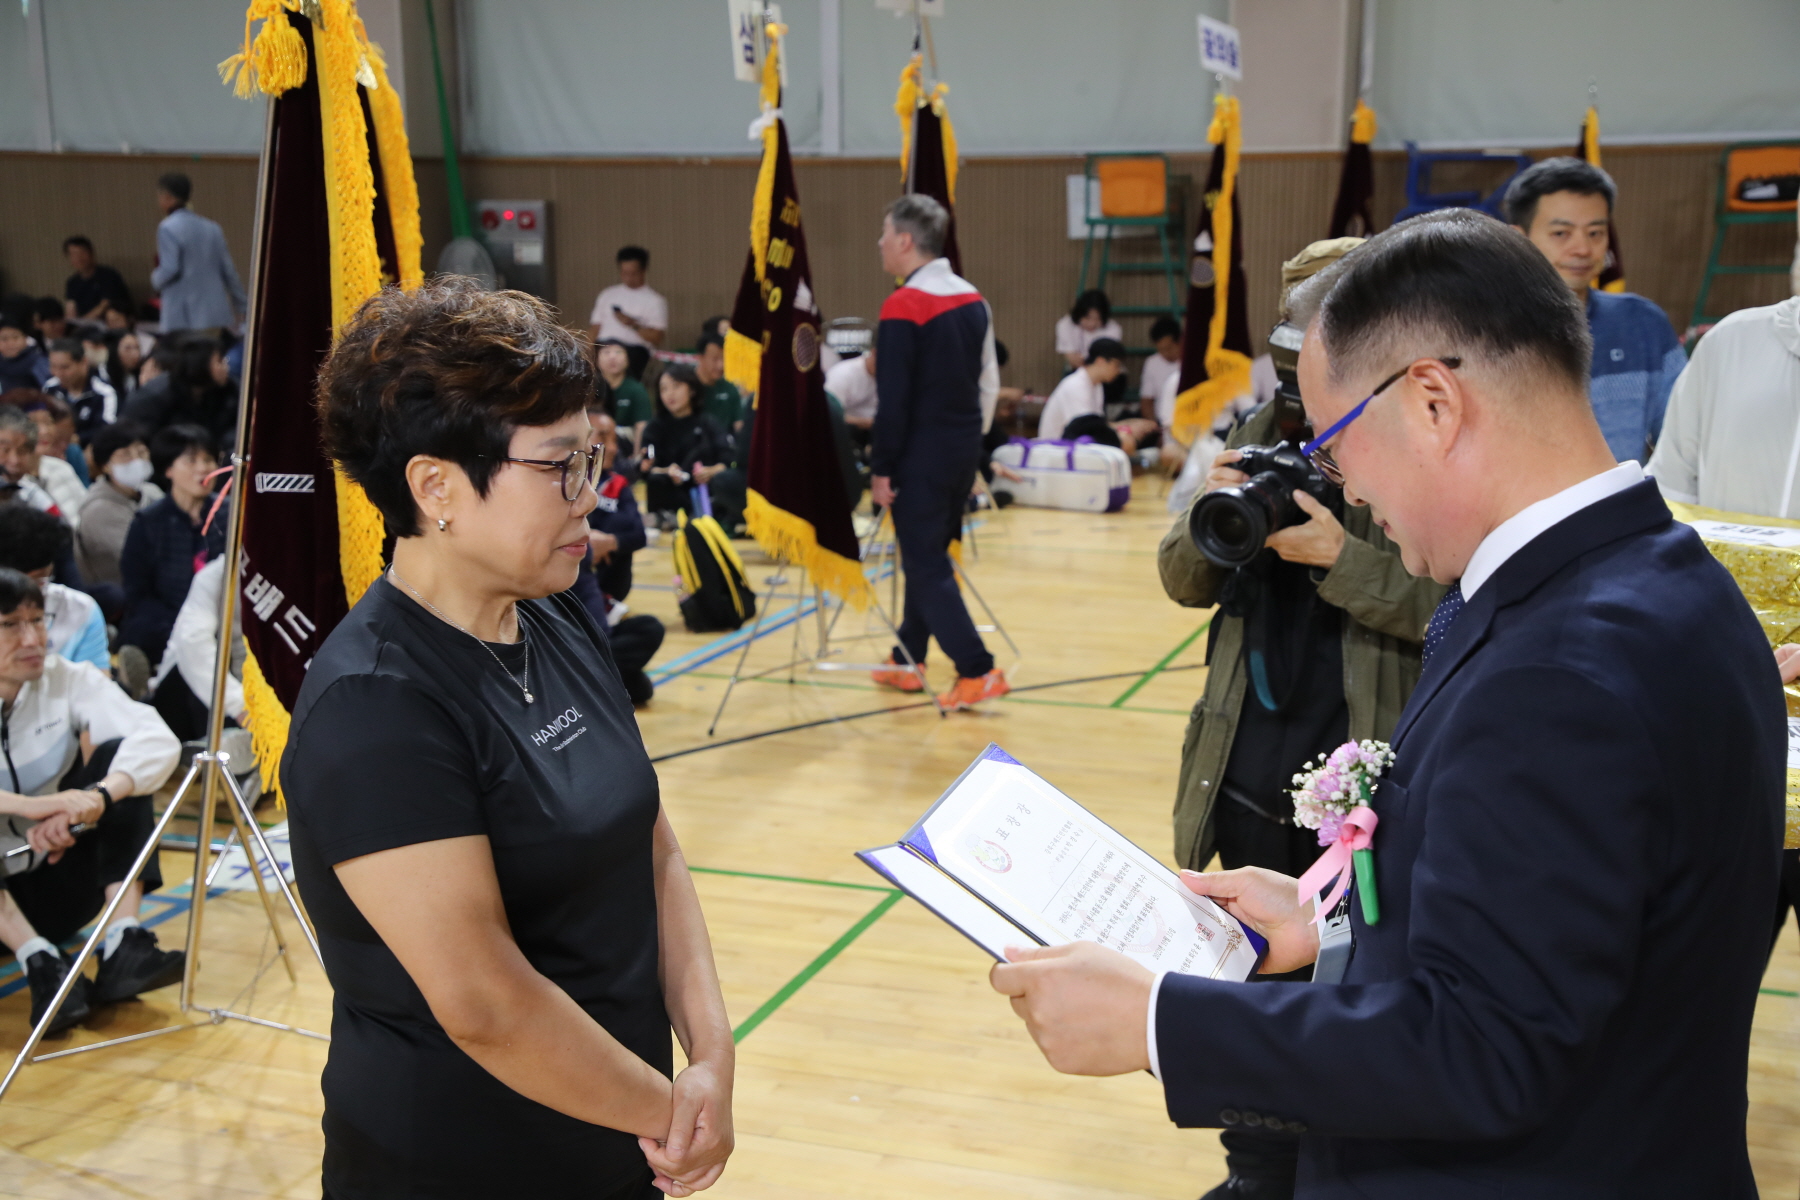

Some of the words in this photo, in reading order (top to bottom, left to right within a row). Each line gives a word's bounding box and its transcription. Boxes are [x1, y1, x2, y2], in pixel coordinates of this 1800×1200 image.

[1044, 820, 1074, 855] 강북구배드민턴협회
[1067, 896, 1082, 912] 평소에
[1077, 877, 1096, 899] 배드민턴에
[1103, 850, 1115, 863] 이해와
[1137, 874, 1148, 884] 우수
[1085, 894, 1108, 923] 봉사활동으로
